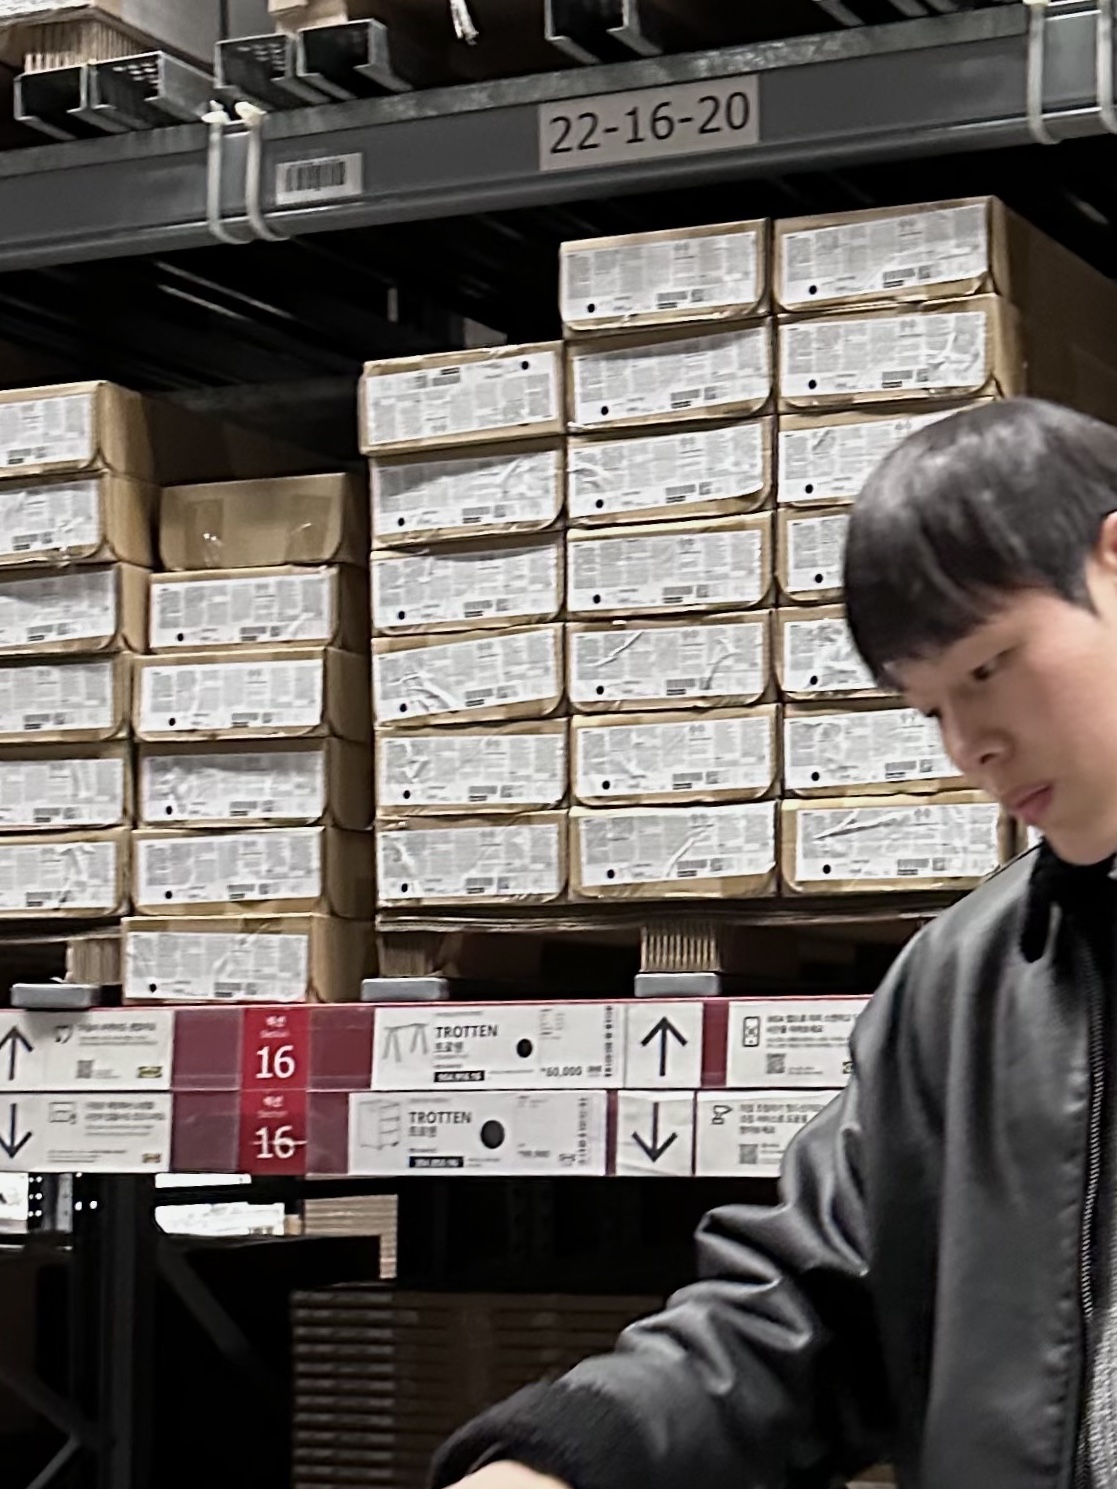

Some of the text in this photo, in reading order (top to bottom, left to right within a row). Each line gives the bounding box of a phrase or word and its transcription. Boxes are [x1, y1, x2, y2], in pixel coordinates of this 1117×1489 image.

[549, 91, 750, 154] 22-16-20
[435, 1024, 499, 1039] TROTTEN
[256, 1044, 296, 1079] 16
[408, 1110, 472, 1124] TROTTEN
[255, 1124, 295, 1159] 16
